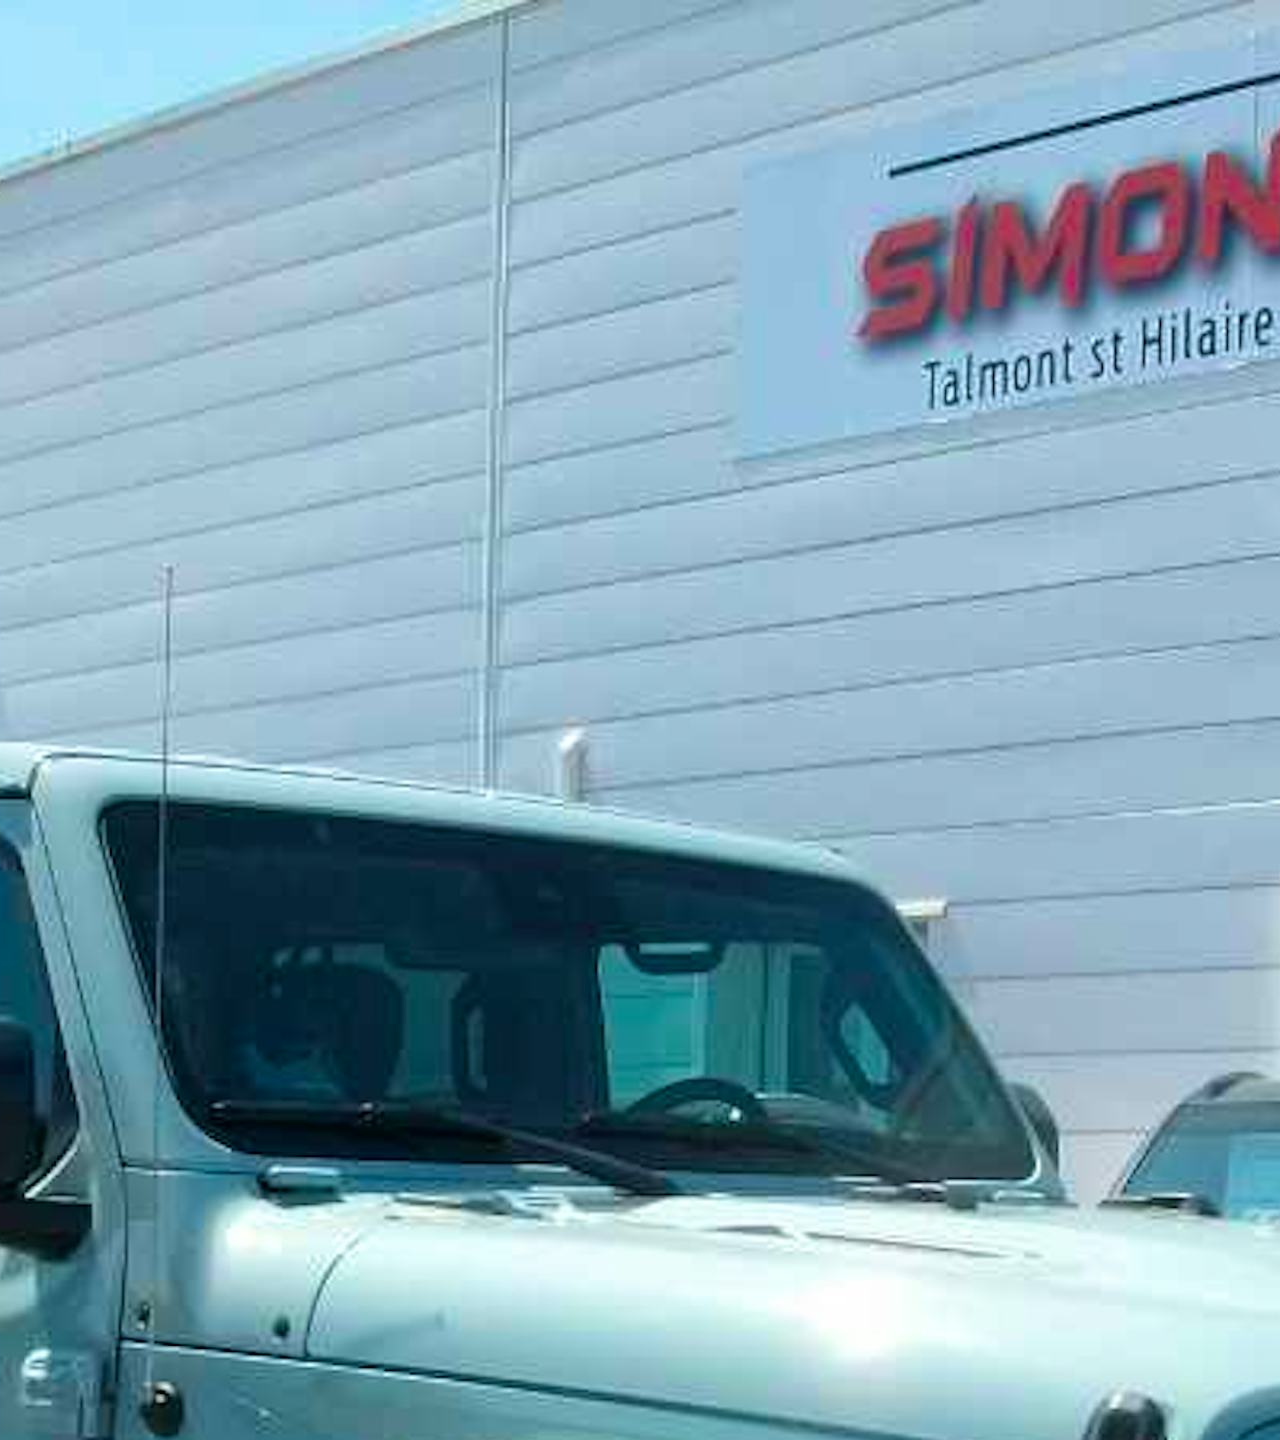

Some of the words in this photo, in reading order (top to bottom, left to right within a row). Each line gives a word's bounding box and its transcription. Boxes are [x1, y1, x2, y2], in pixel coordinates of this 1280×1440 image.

[923, 337, 1074, 410] Talmont
[1090, 328, 1123, 378] st
[1141, 303, 1275, 368] Hilaire
